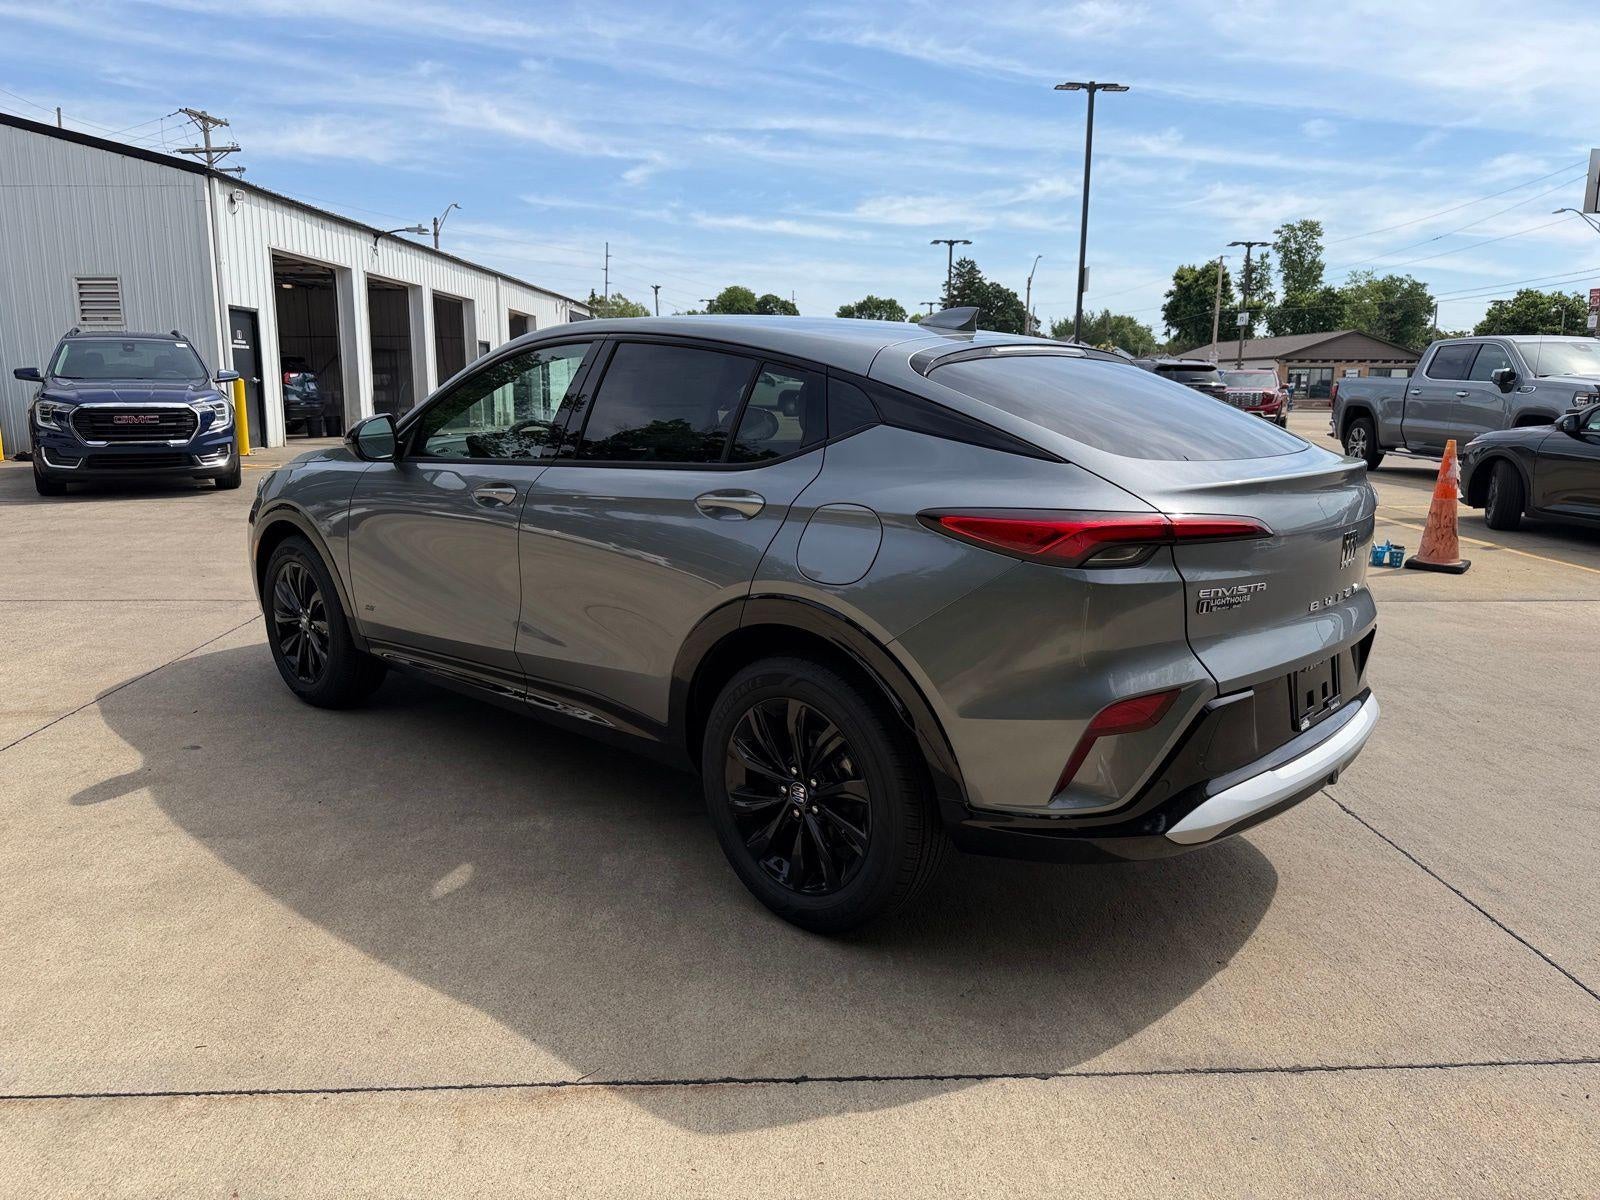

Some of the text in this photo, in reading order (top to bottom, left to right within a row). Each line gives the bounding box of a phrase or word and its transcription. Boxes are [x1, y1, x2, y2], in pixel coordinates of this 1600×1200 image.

[113, 415, 160, 424] GMC
[1199, 583, 1267, 598] ENVISTA
[1210, 595, 1251, 606] LIGHTHOUSE
